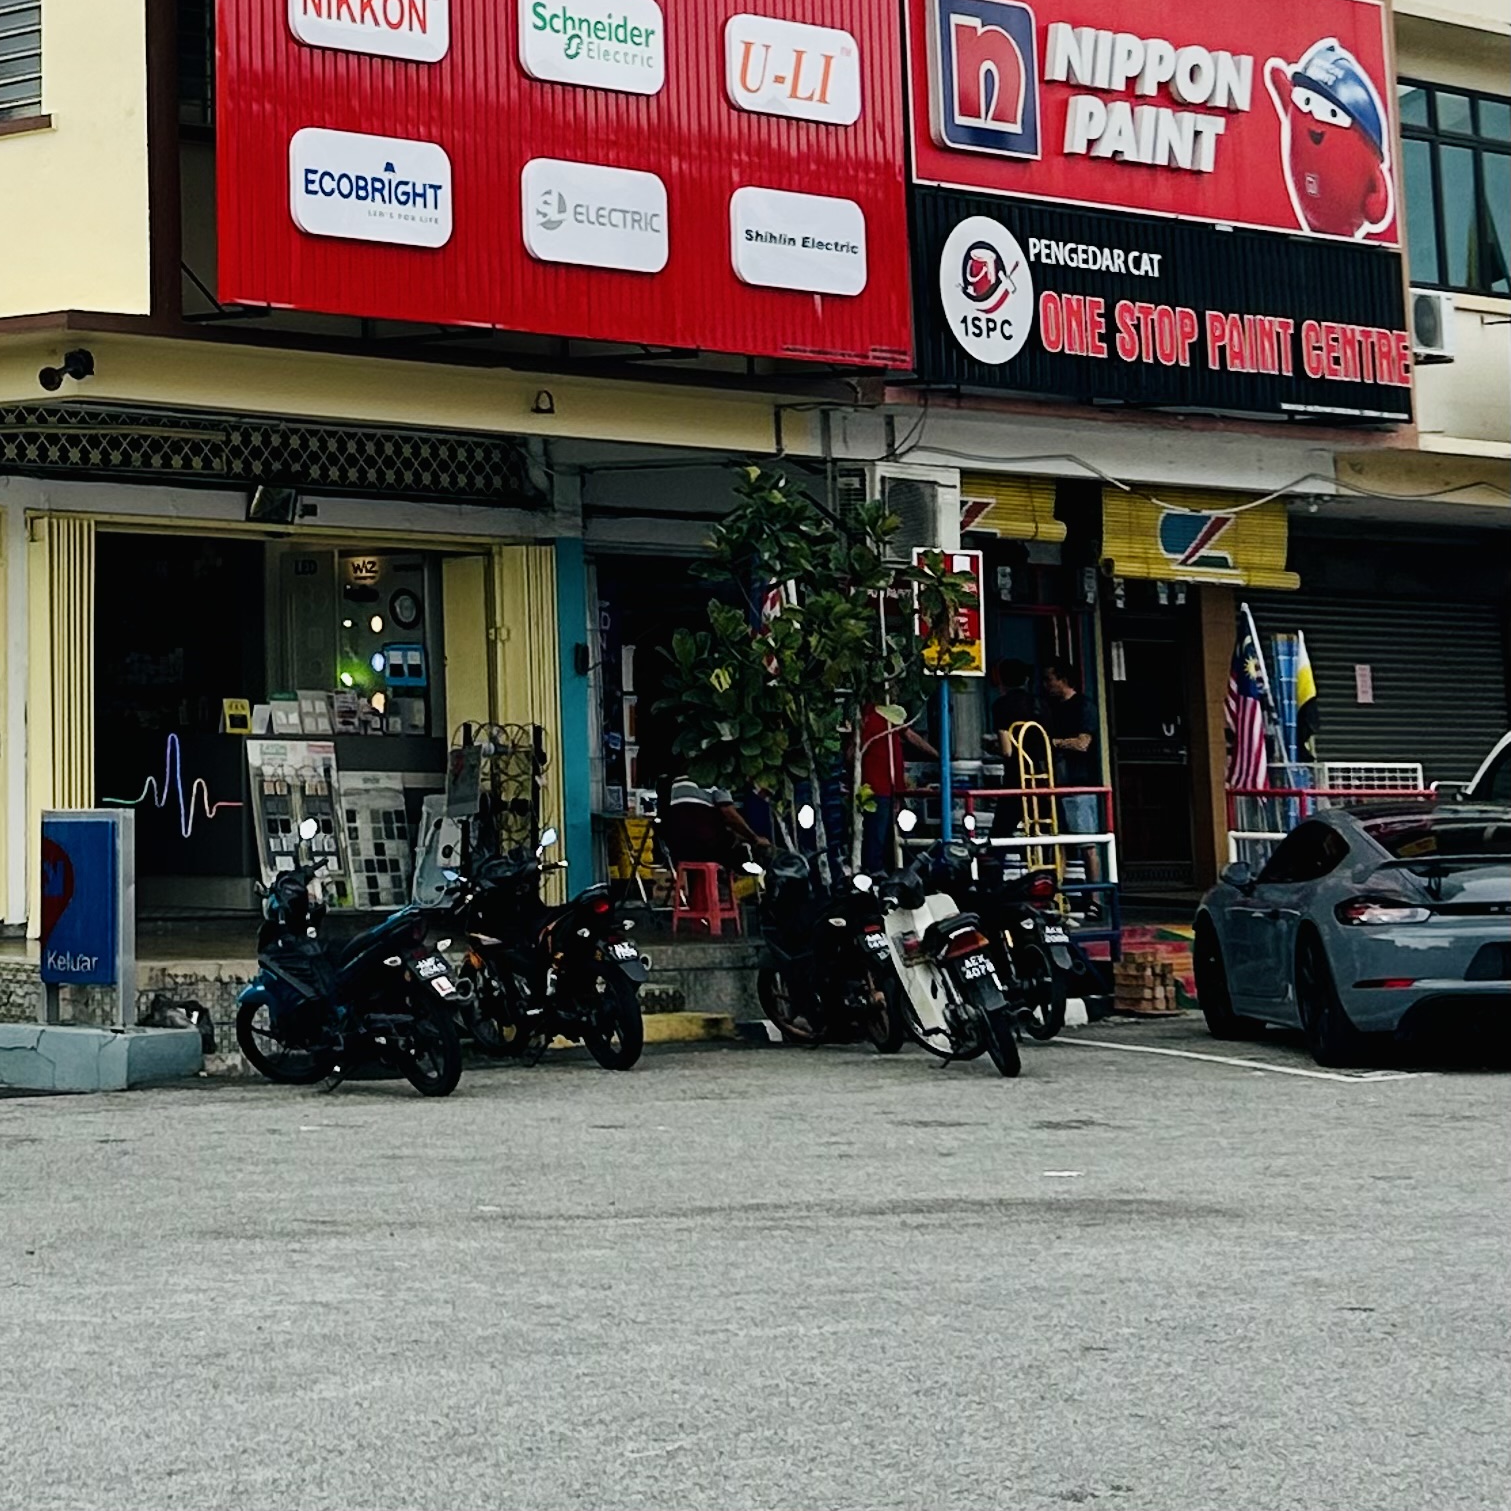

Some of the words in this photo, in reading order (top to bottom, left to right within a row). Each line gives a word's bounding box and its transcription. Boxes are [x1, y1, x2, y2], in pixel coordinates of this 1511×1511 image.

[531, 1, 656, 48] Schneider
[586, 40, 654, 69] Electric
[740, 40, 835, 105] U-LI
[1044, 22, 1254, 112] NIPPON
[1064, 95, 1226, 173] PAINT
[304, 168, 443, 210] ECOBRIGHT
[574, 204, 661, 233] ELECTRIC
[745, 229, 796, 248] Shihlin
[801, 236, 859, 256] Electric
[1029, 237, 1125, 274] PENGEDAR
[1128, 250, 1163, 278] CAT
[960, 315, 1013, 341] 1SPC
[1040, 290, 1108, 358] ONE
[1115, 300, 1197, 367] STOP
[1206, 311, 1293, 376] PAINT
[1302, 320, 1411, 388] CENTRE
